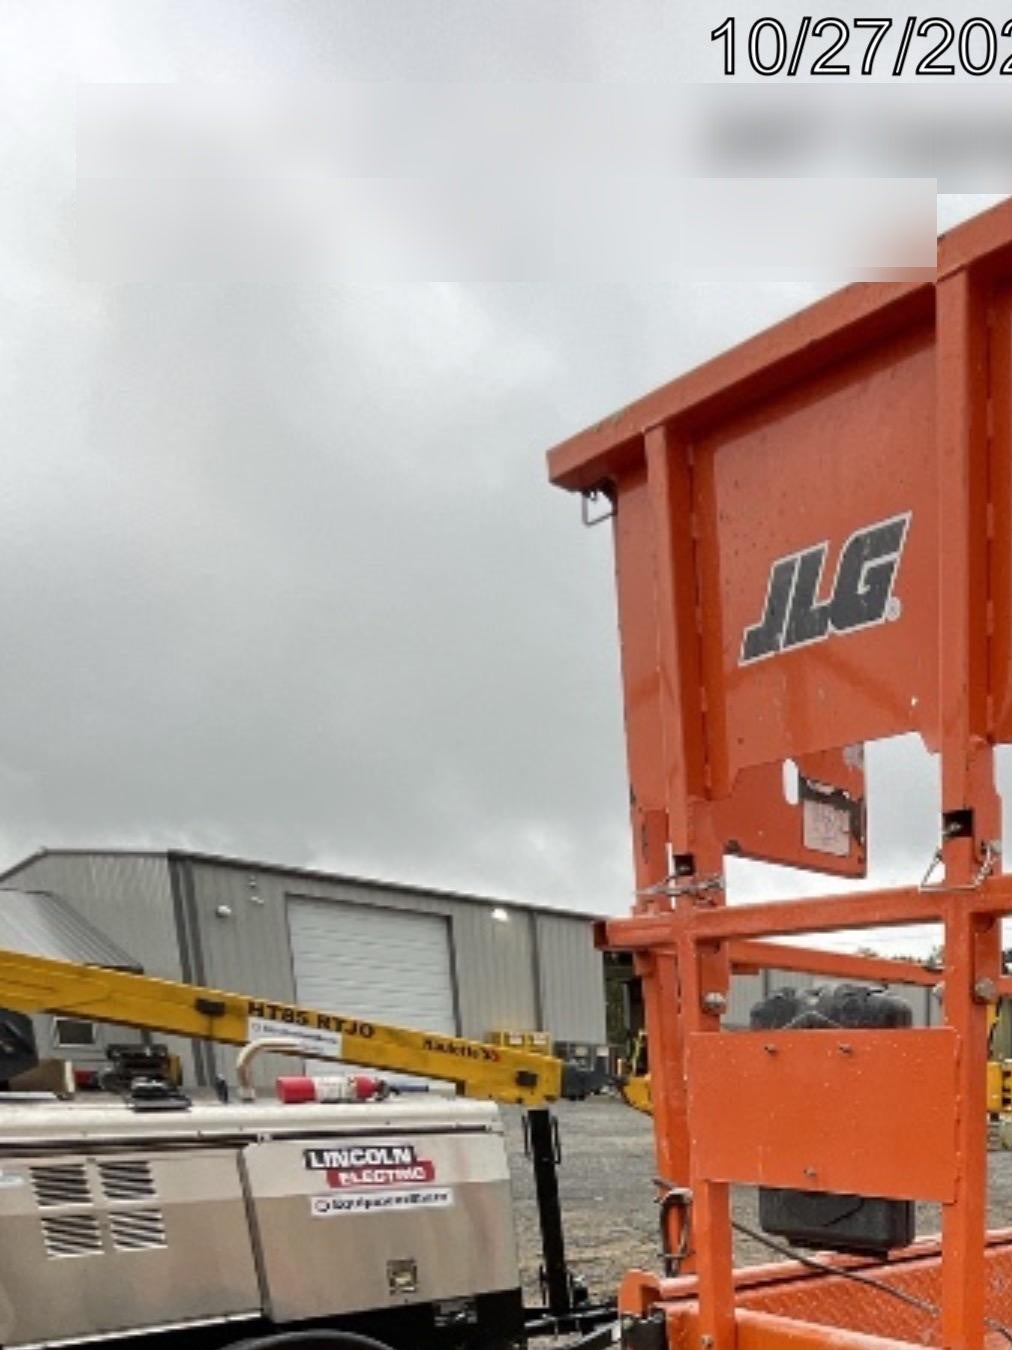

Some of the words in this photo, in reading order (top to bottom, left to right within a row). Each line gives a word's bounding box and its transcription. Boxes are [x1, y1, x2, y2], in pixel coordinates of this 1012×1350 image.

[738, 510, 912, 667] JLG
[247, 1001, 309, 1025] HT85
[310, 1147, 413, 1169] LINCOLN
